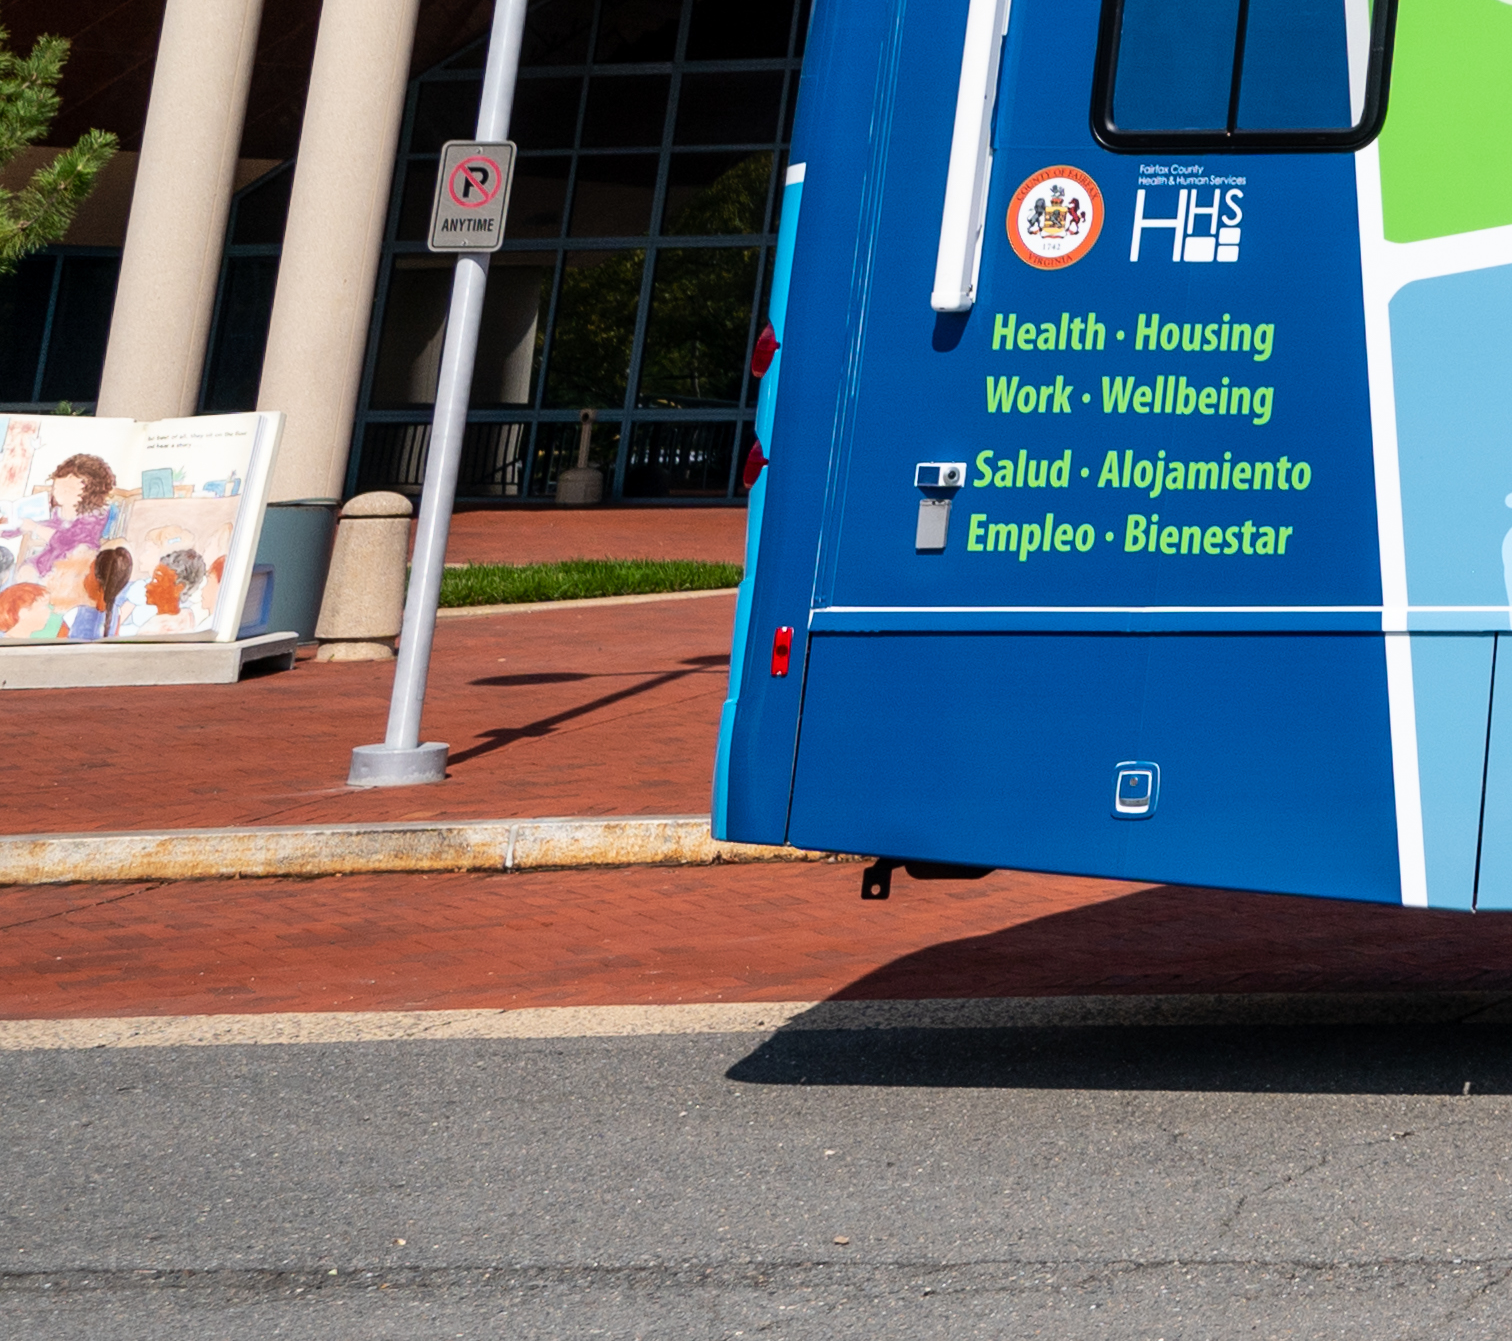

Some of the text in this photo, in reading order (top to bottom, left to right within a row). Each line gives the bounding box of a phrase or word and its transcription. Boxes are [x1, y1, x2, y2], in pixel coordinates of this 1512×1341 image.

[1016, 169, 1099, 201] COUNTY OF FAIRFAX
[1138, 175, 1246, 186] Health & Human Services
[1139, 164, 1204, 175] Fairfax County
[441, 218, 494, 232] ANYTIME
[1130, 188, 1244, 262] HHS
[1028, 253, 1073, 267] VIRGINIA
[1042, 243, 1061, 251] 1742
[991, 313, 1275, 361] Health Housing
[985, 375, 1275, 425] Work Wellbeing
[973, 449, 1312, 498] Salud Alojamiento
[966, 513, 1293, 561] Empleo Bienestar
